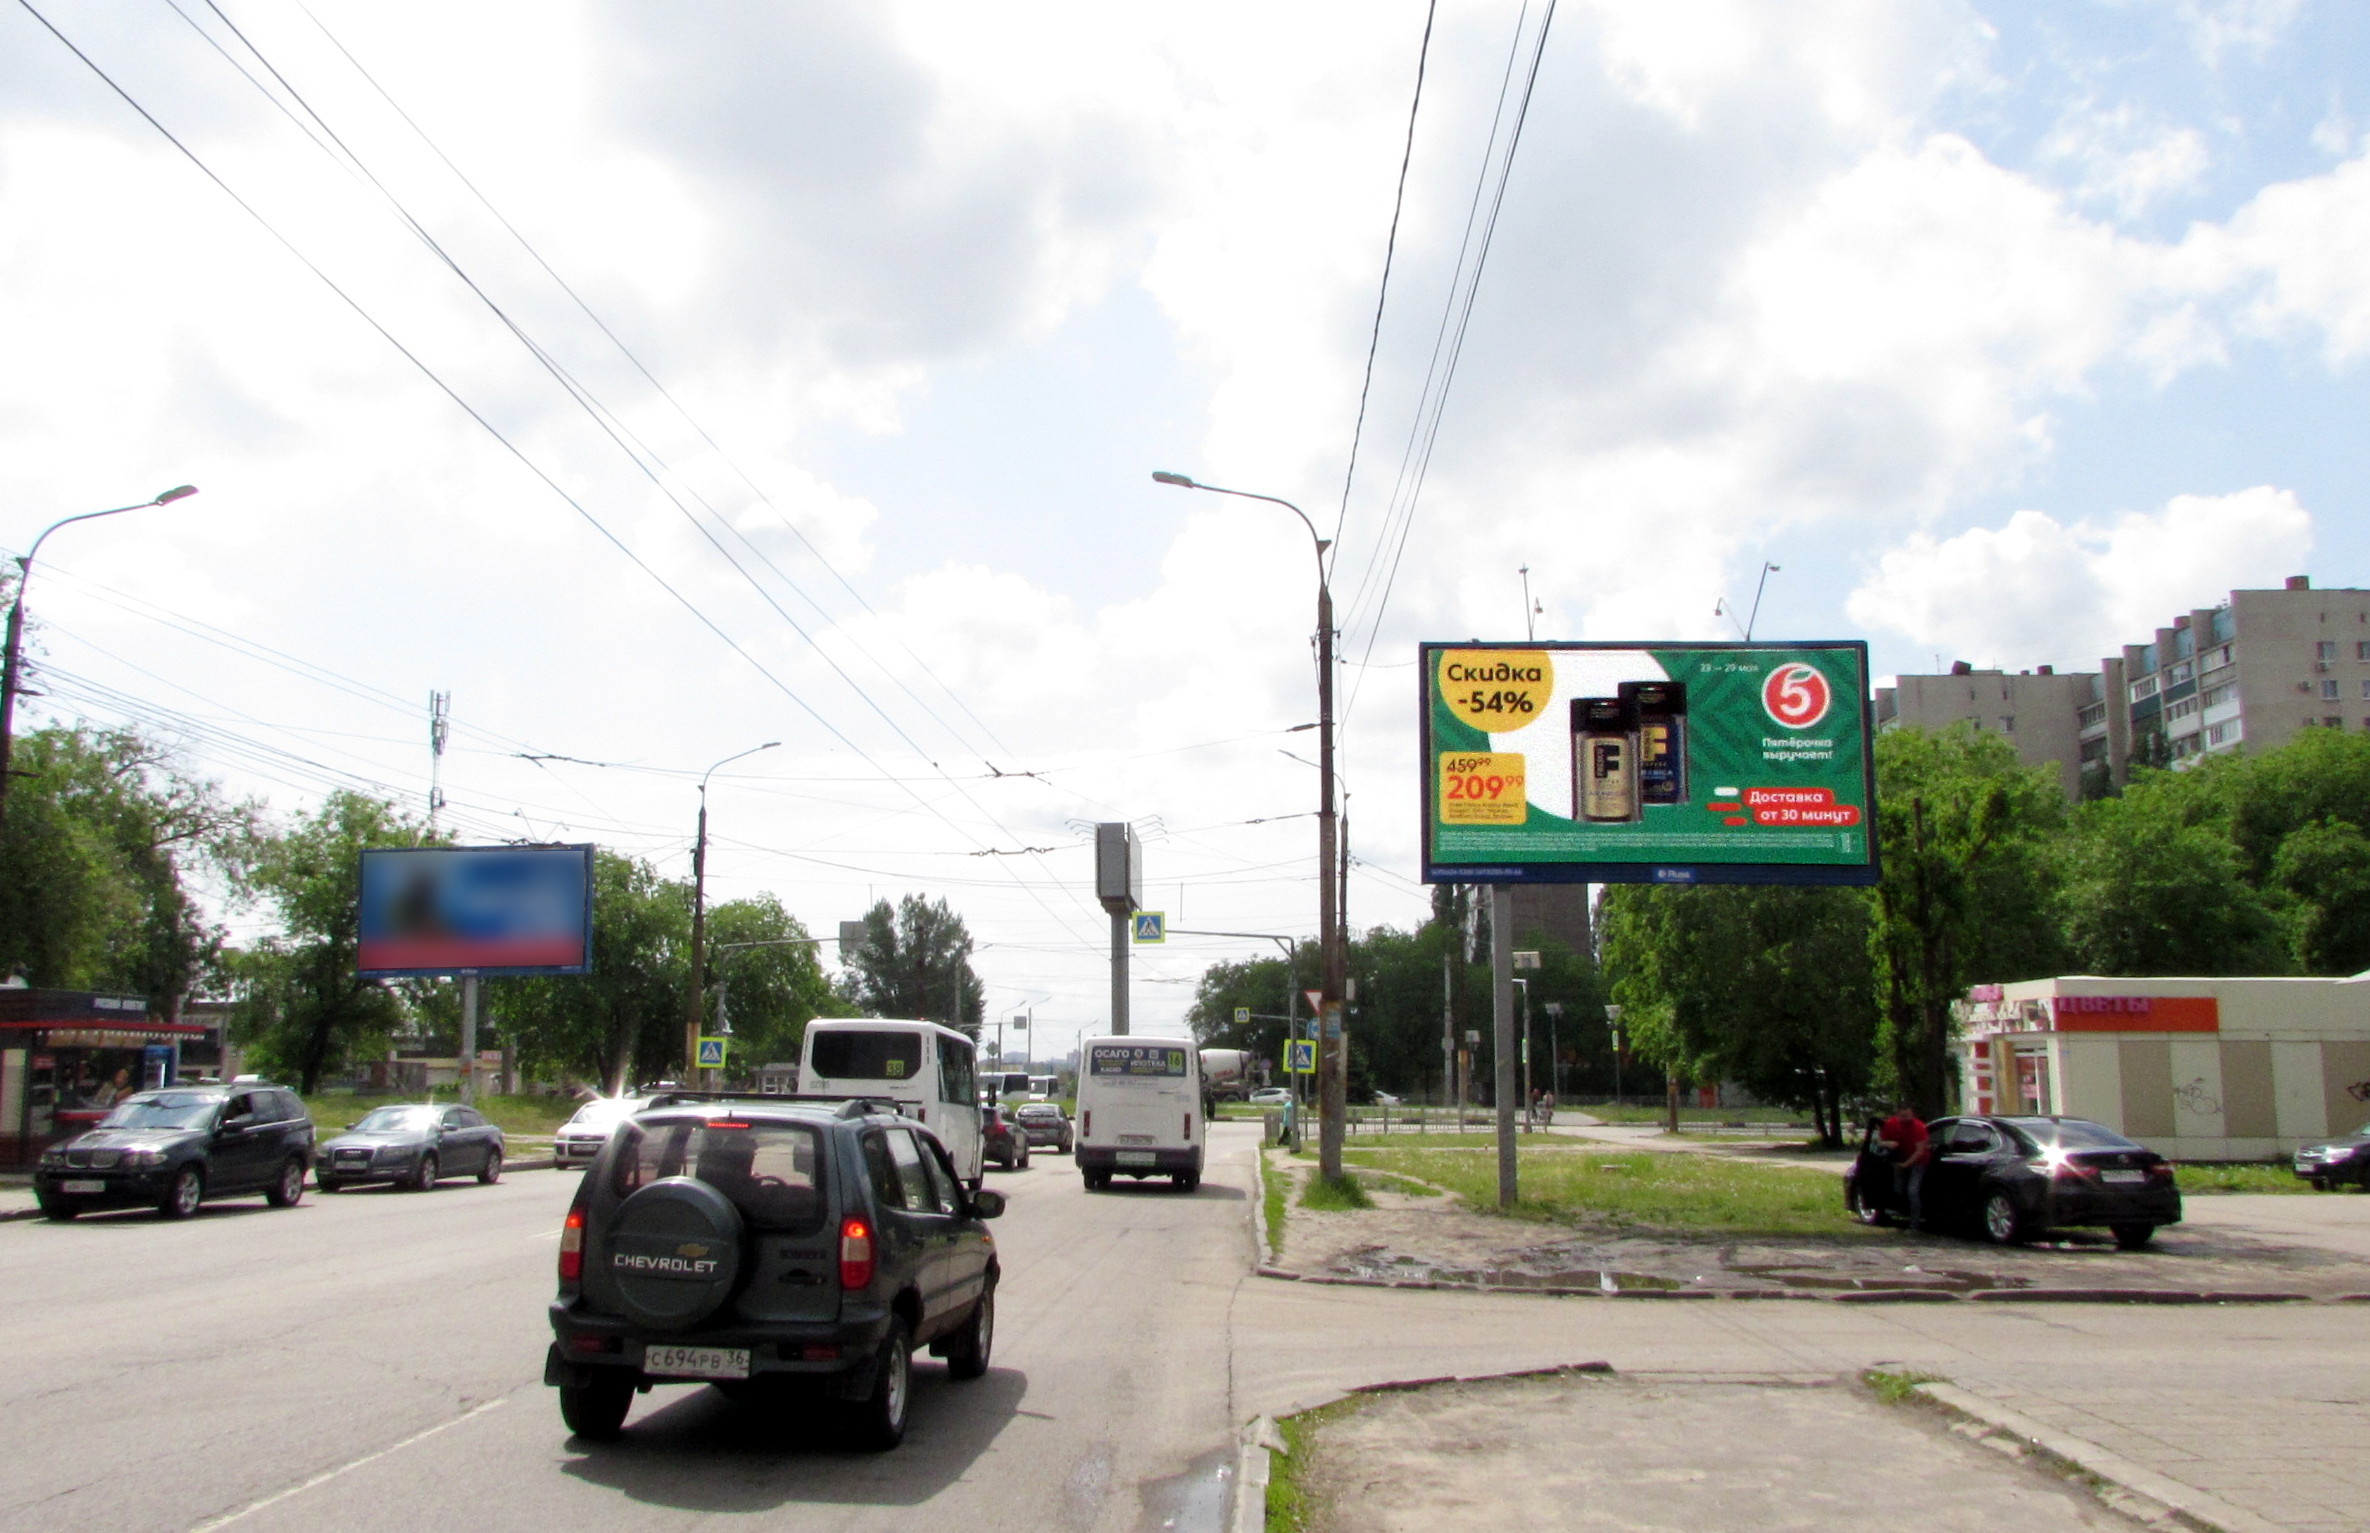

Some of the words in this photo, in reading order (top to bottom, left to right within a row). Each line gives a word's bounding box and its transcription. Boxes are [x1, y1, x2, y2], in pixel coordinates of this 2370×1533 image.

[1447, 663, 1541, 682] Скидка
[1458, 691, 1533, 713] -54%
[1762, 737, 1834, 749] Пятёрочка
[1762, 750, 1834, 761] выручает!
[1750, 790, 1823, 804] Доставка
[1760, 810, 1777, 821] от
[1781, 809, 1798, 821] 30
[1802, 811, 1851, 824] минут
[2058, 996, 2149, 1013] ЦВЕТЫ
[1094, 1048, 1130, 1059] ОСАГО
[1169, 1053, 1181, 1066] 16
[614, 1253, 718, 1273] CHEVROLET
